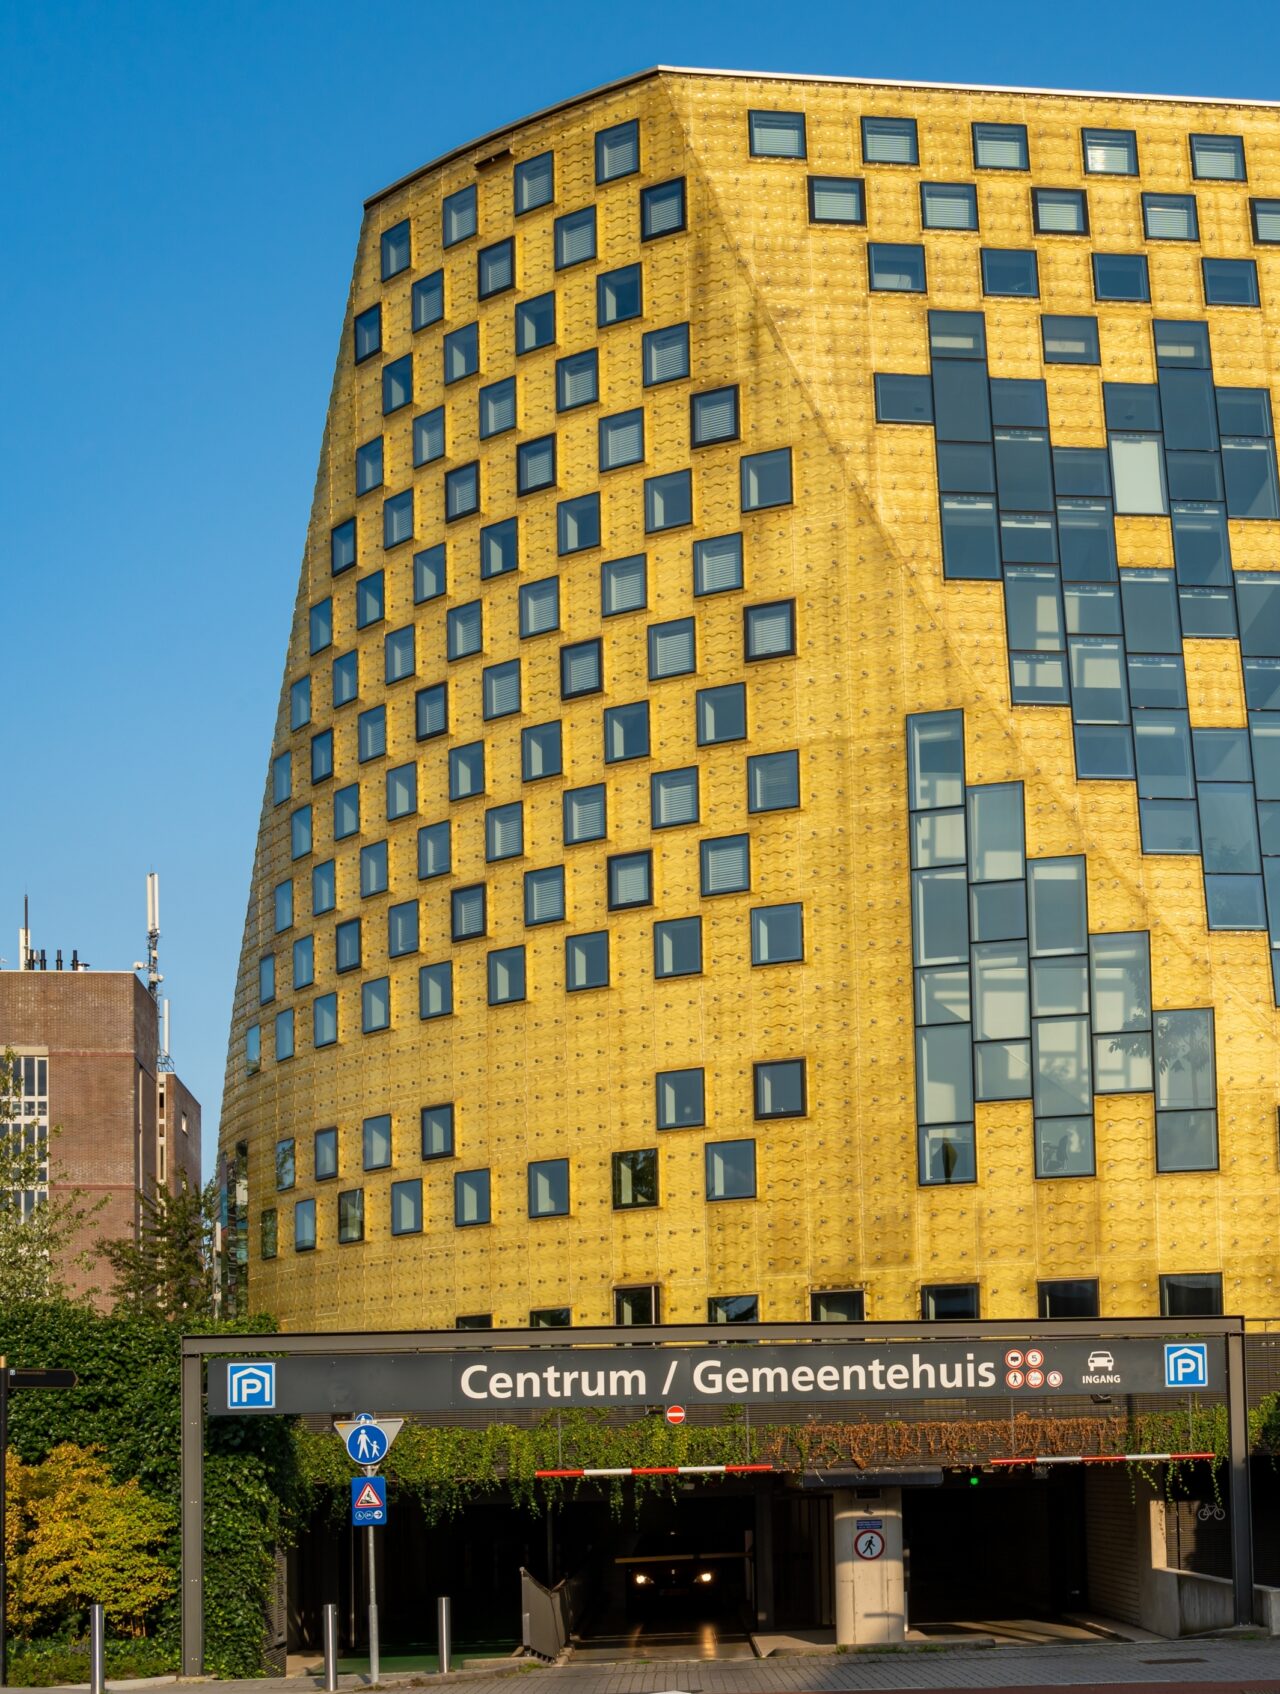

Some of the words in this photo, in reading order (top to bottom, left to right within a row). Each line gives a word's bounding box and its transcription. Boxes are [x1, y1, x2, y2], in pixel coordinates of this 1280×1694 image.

[1031, 1355, 1038, 1363] 5
[460, 1364, 647, 1399] Centrum
[661, 1360, 679, 1395] /
[692, 1353, 997, 1394] Gemeentehuis
[1082, 1374, 1121, 1384] INGANG
